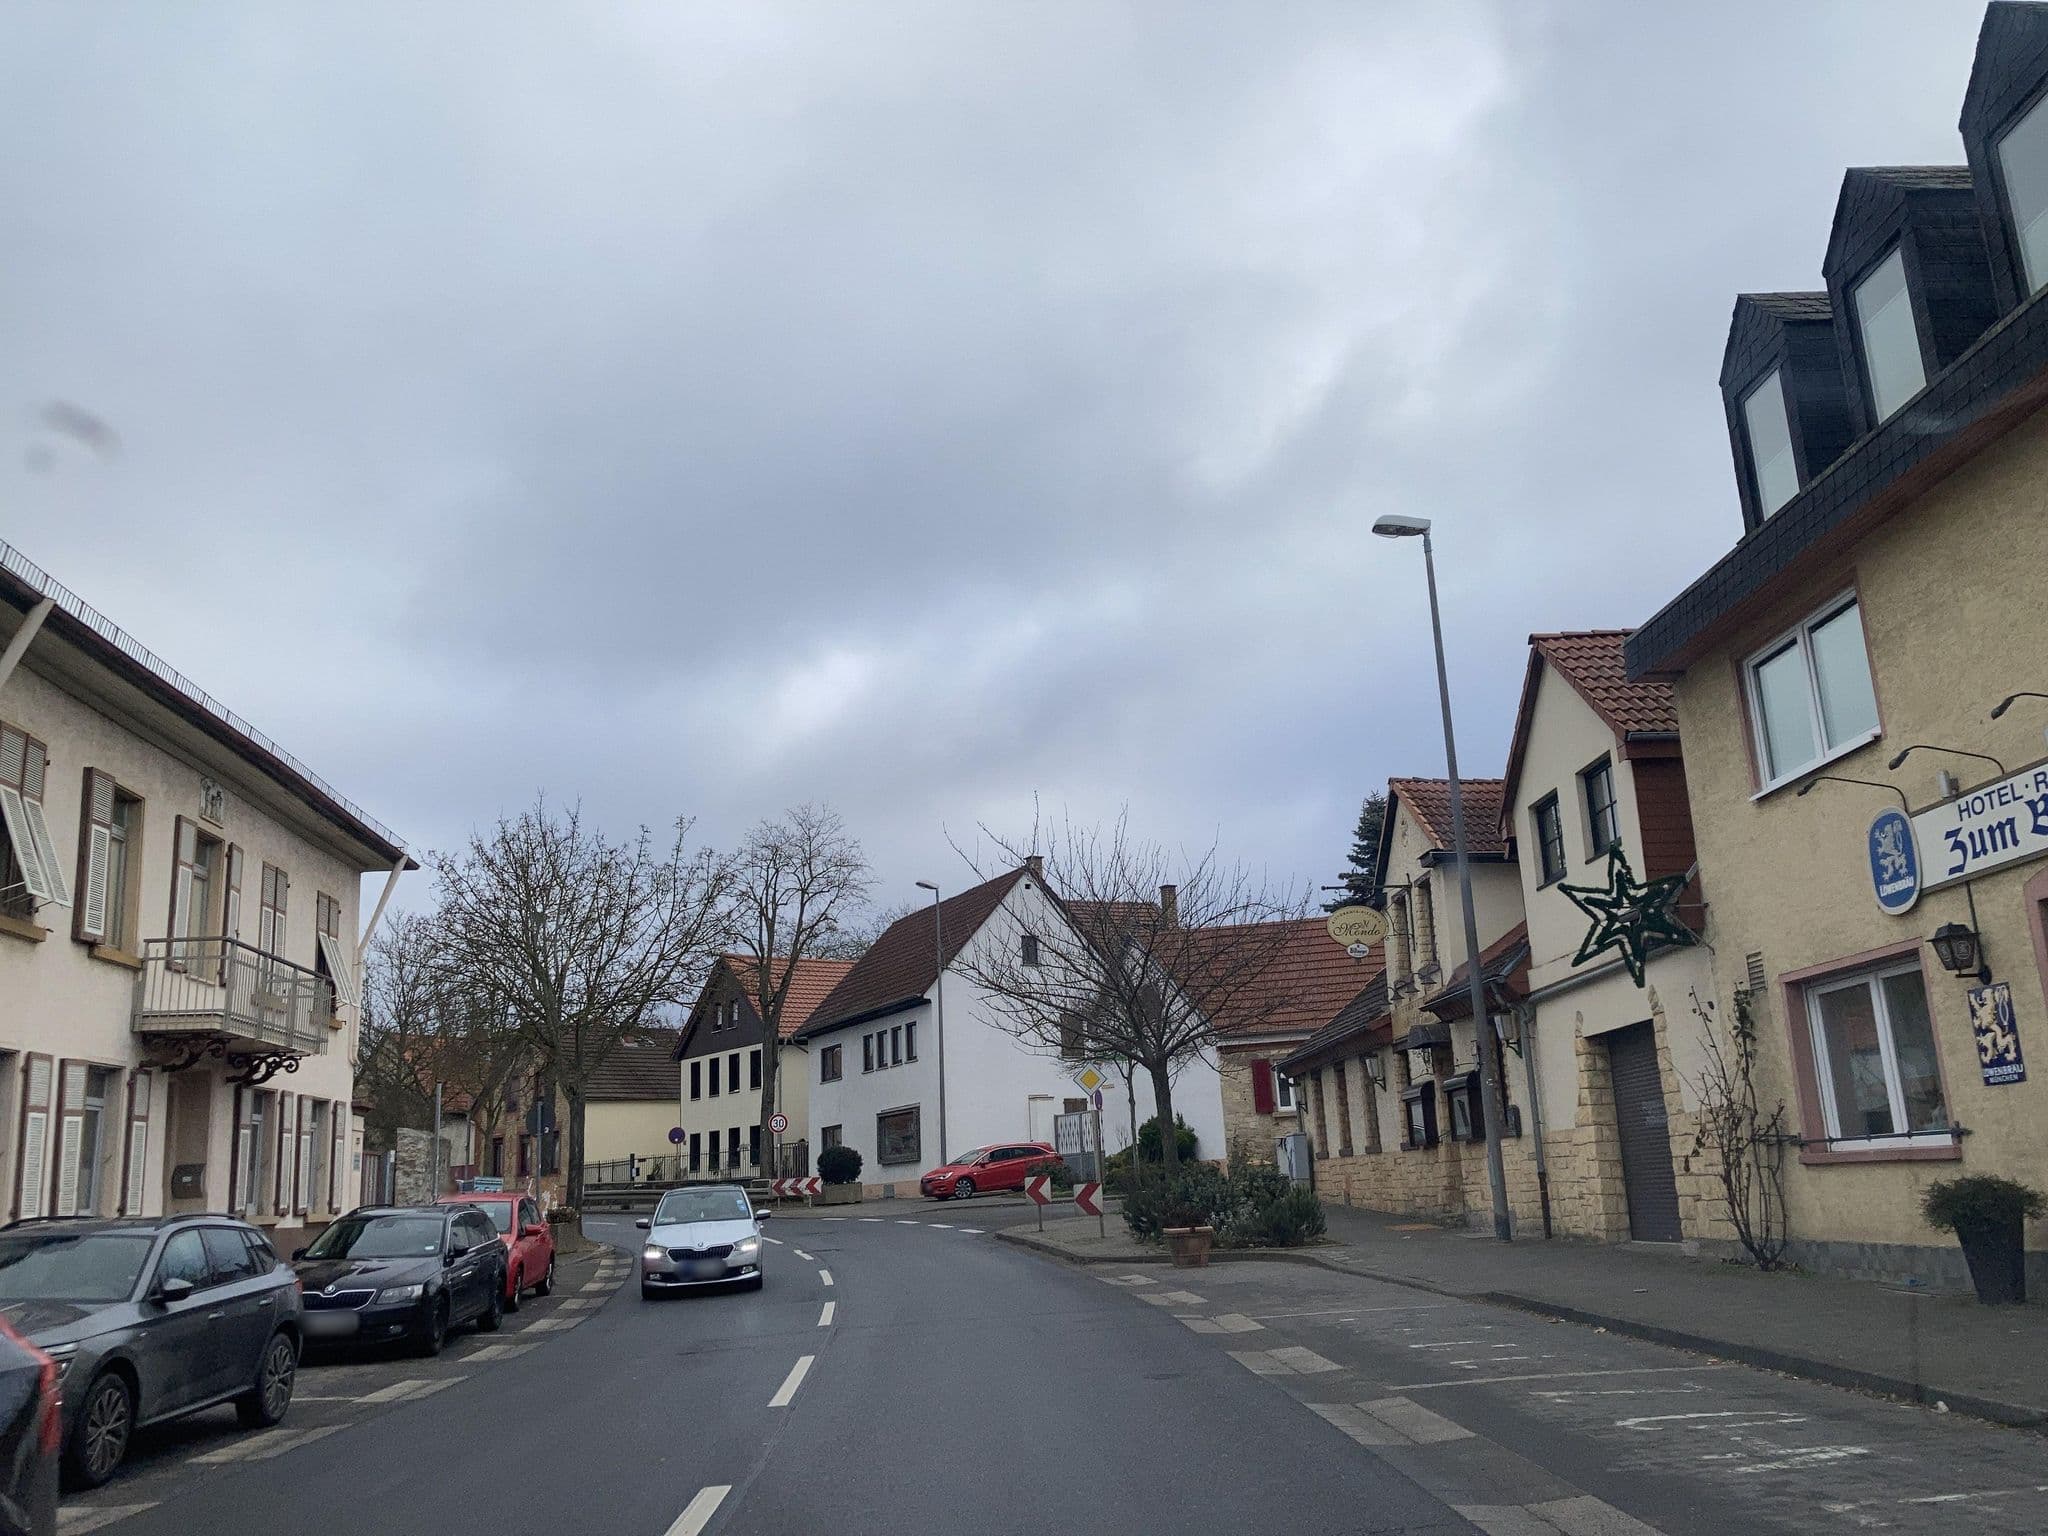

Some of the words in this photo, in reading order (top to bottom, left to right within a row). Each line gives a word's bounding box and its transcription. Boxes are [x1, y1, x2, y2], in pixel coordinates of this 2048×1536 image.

[1958, 783, 2024, 822] HOTEL
[1944, 817, 2020, 876] Zum
[1333, 922, 1380, 937] Mondo
[773, 1118, 785, 1128] 30
